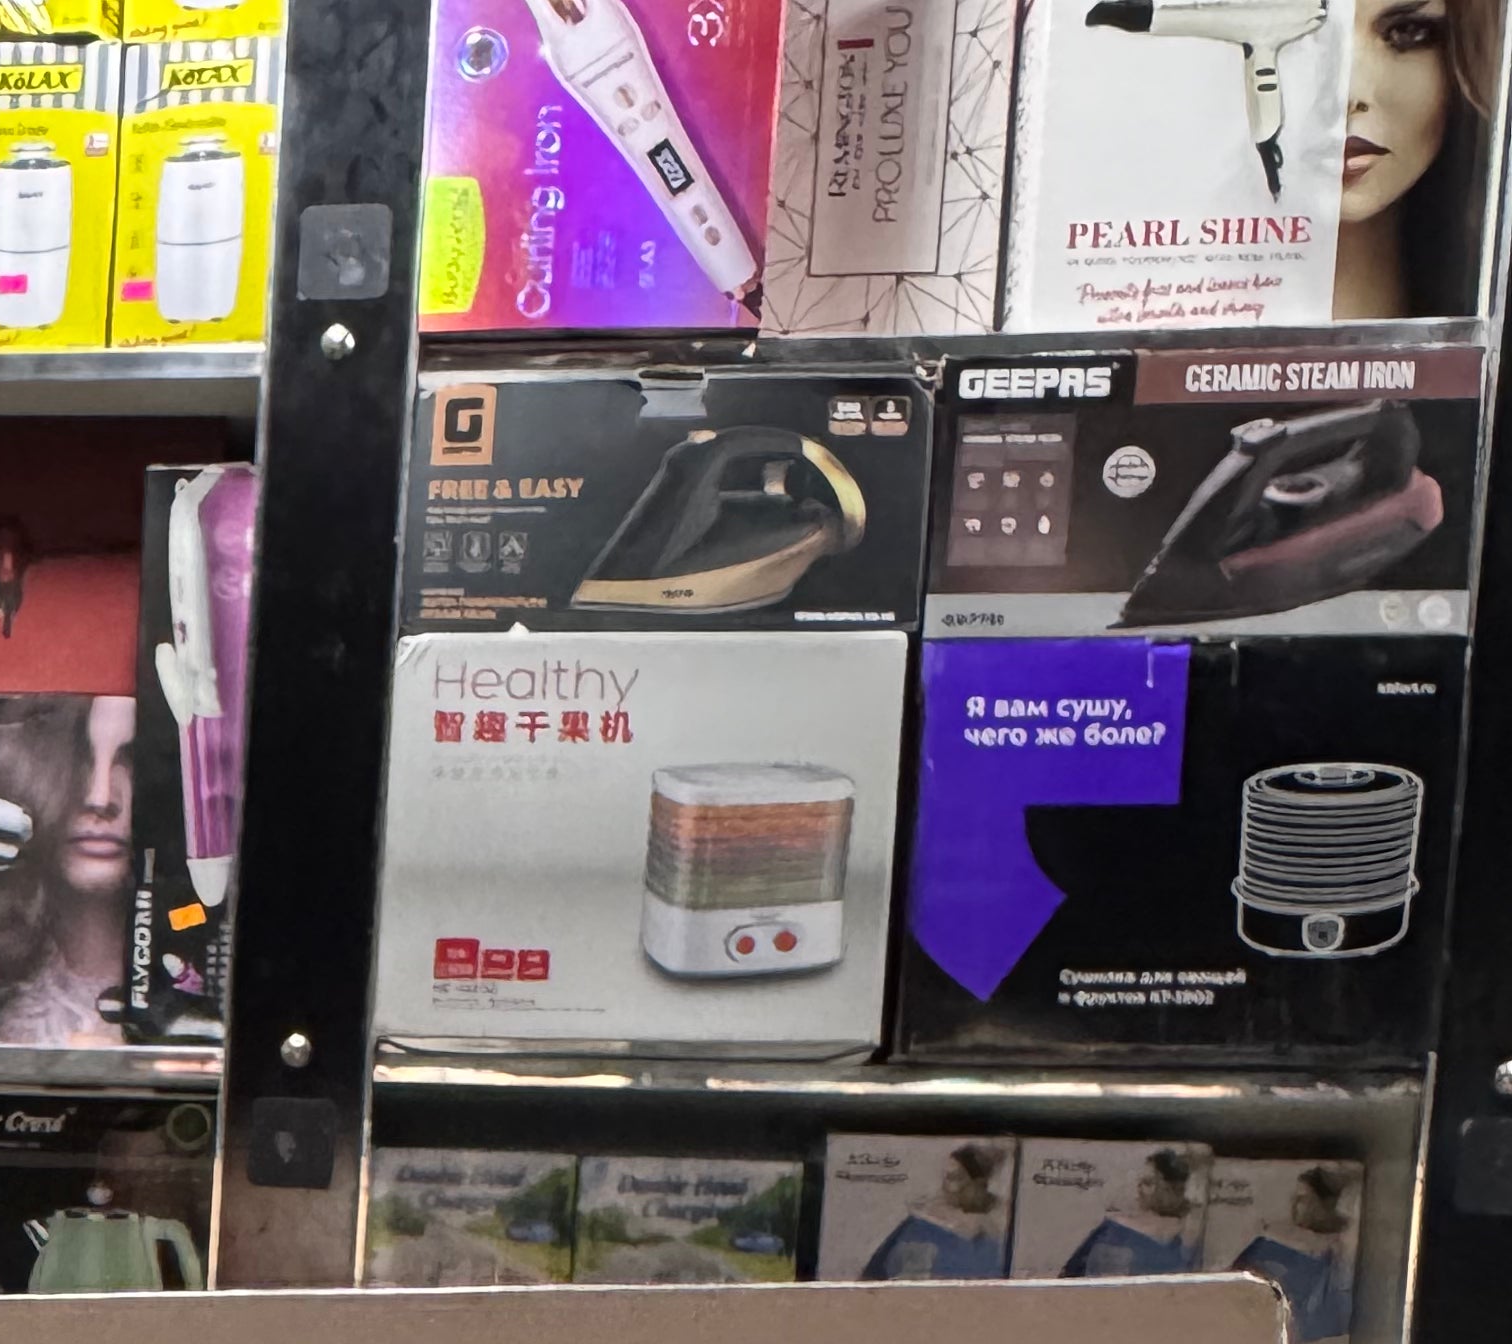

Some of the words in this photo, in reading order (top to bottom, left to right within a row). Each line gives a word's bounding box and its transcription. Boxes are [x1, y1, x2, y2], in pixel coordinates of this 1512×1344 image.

[1065, 219, 1190, 249] PEARL
[1199, 215, 1313, 245] SHINE
[958, 366, 1112, 399] GEEPAS
[1184, 363, 1282, 392] CERAMIC
[1285, 362, 1359, 391] STEAM
[1363, 360, 1416, 389] IRON
[428, 478, 490, 500] FREE
[518, 477, 585, 499] EASY
[432, 658, 640, 709] Healthy
[965, 695, 986, 719] Я
[994, 698, 1049, 718] вам
[963, 726, 1028, 748] чего
[1035, 726, 1077, 747] же
